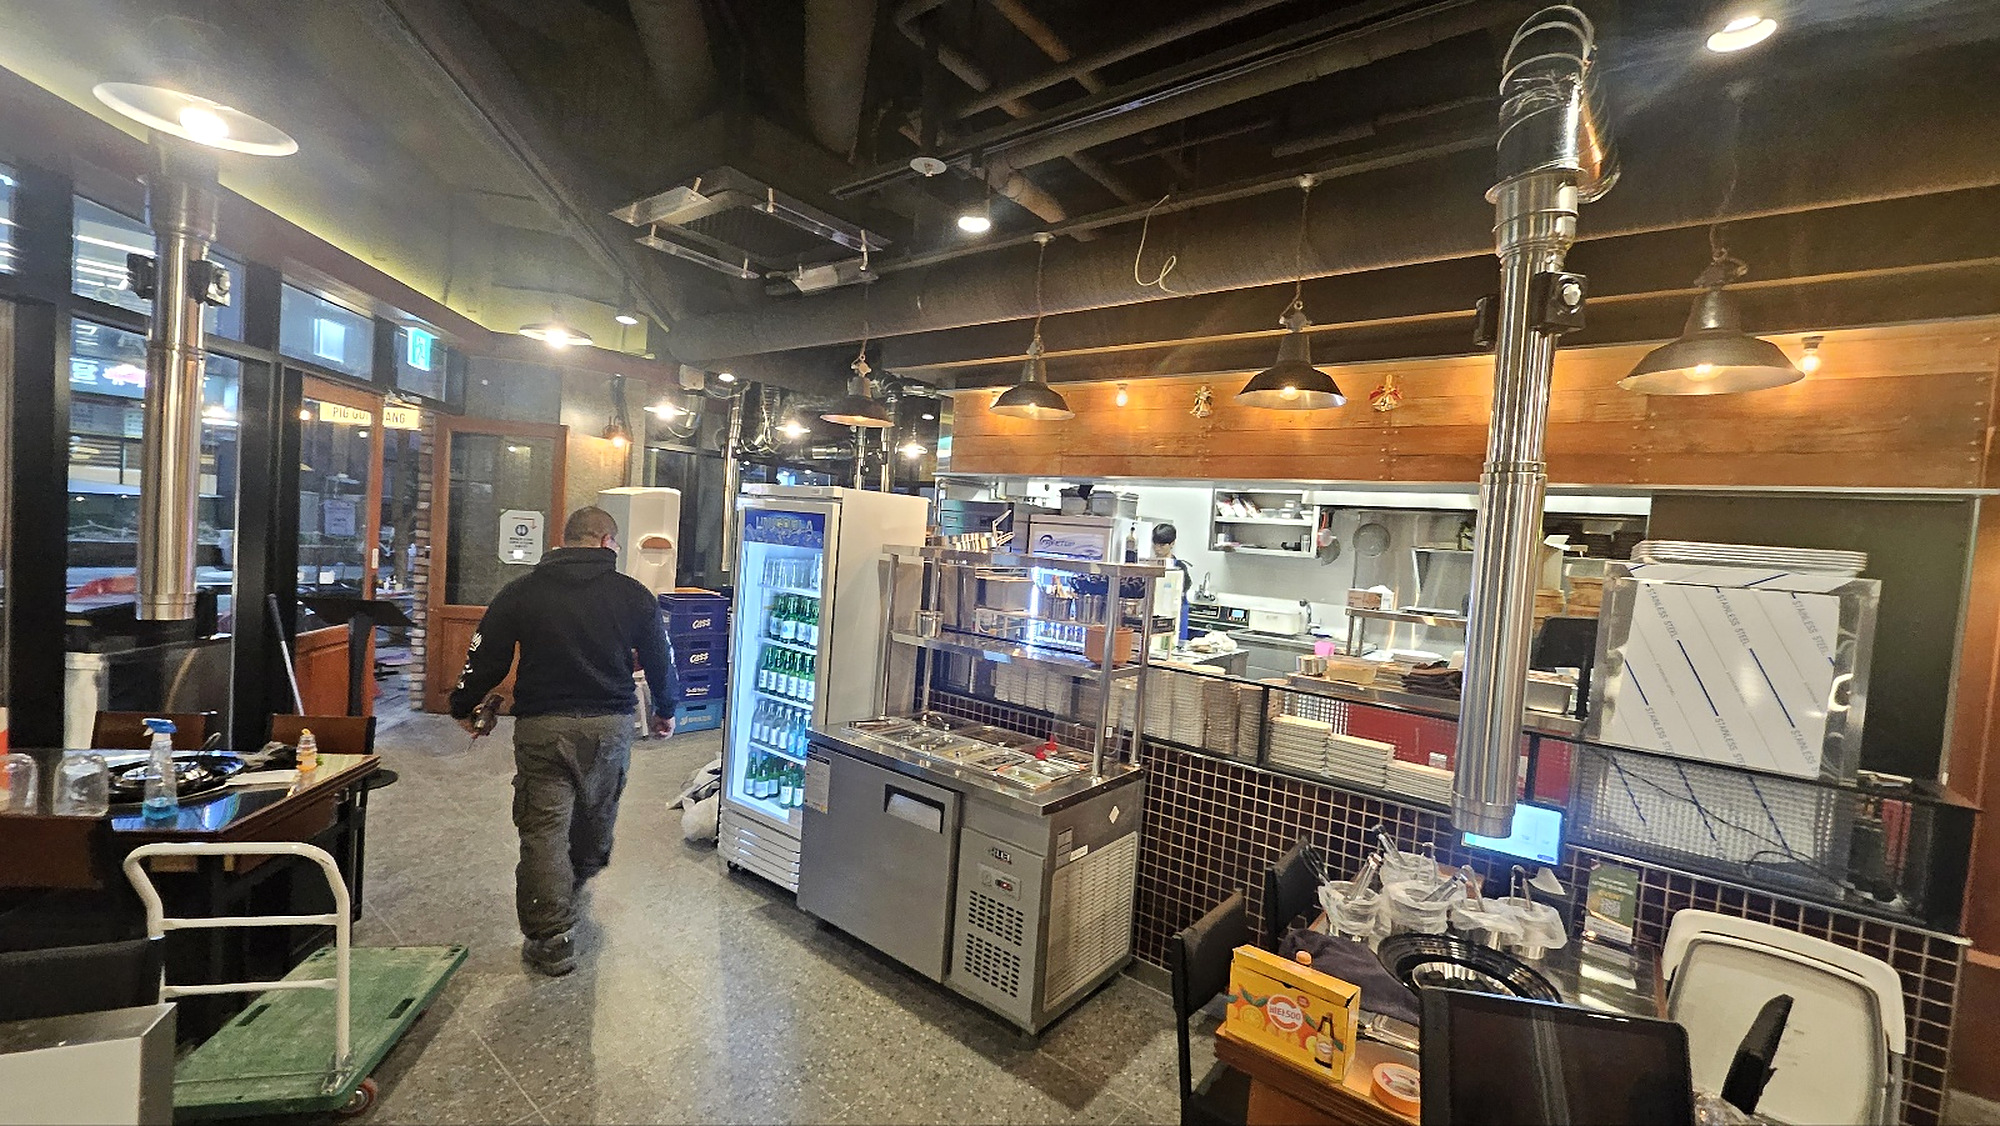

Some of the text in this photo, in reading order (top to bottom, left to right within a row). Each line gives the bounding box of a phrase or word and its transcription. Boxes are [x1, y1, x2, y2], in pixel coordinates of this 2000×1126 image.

[333, 406, 349, 418] PIG
[385, 411, 406, 424] ANG
[1646, 588, 1678, 638] STAINLESS STEEL
[1716, 594, 1750, 646] STAINLESS STEEL
[1792, 600, 1818, 634] STAINLESS
[1812, 635, 1829, 657] STEEL
[1645, 706, 1667, 739] STAINLESS
[1662, 741, 1674, 752] STE
[1714, 718, 1738, 751] STAINLESS
[1733, 753, 1746, 764] STE
[1791, 729, 1816, 764] STAINLESS
